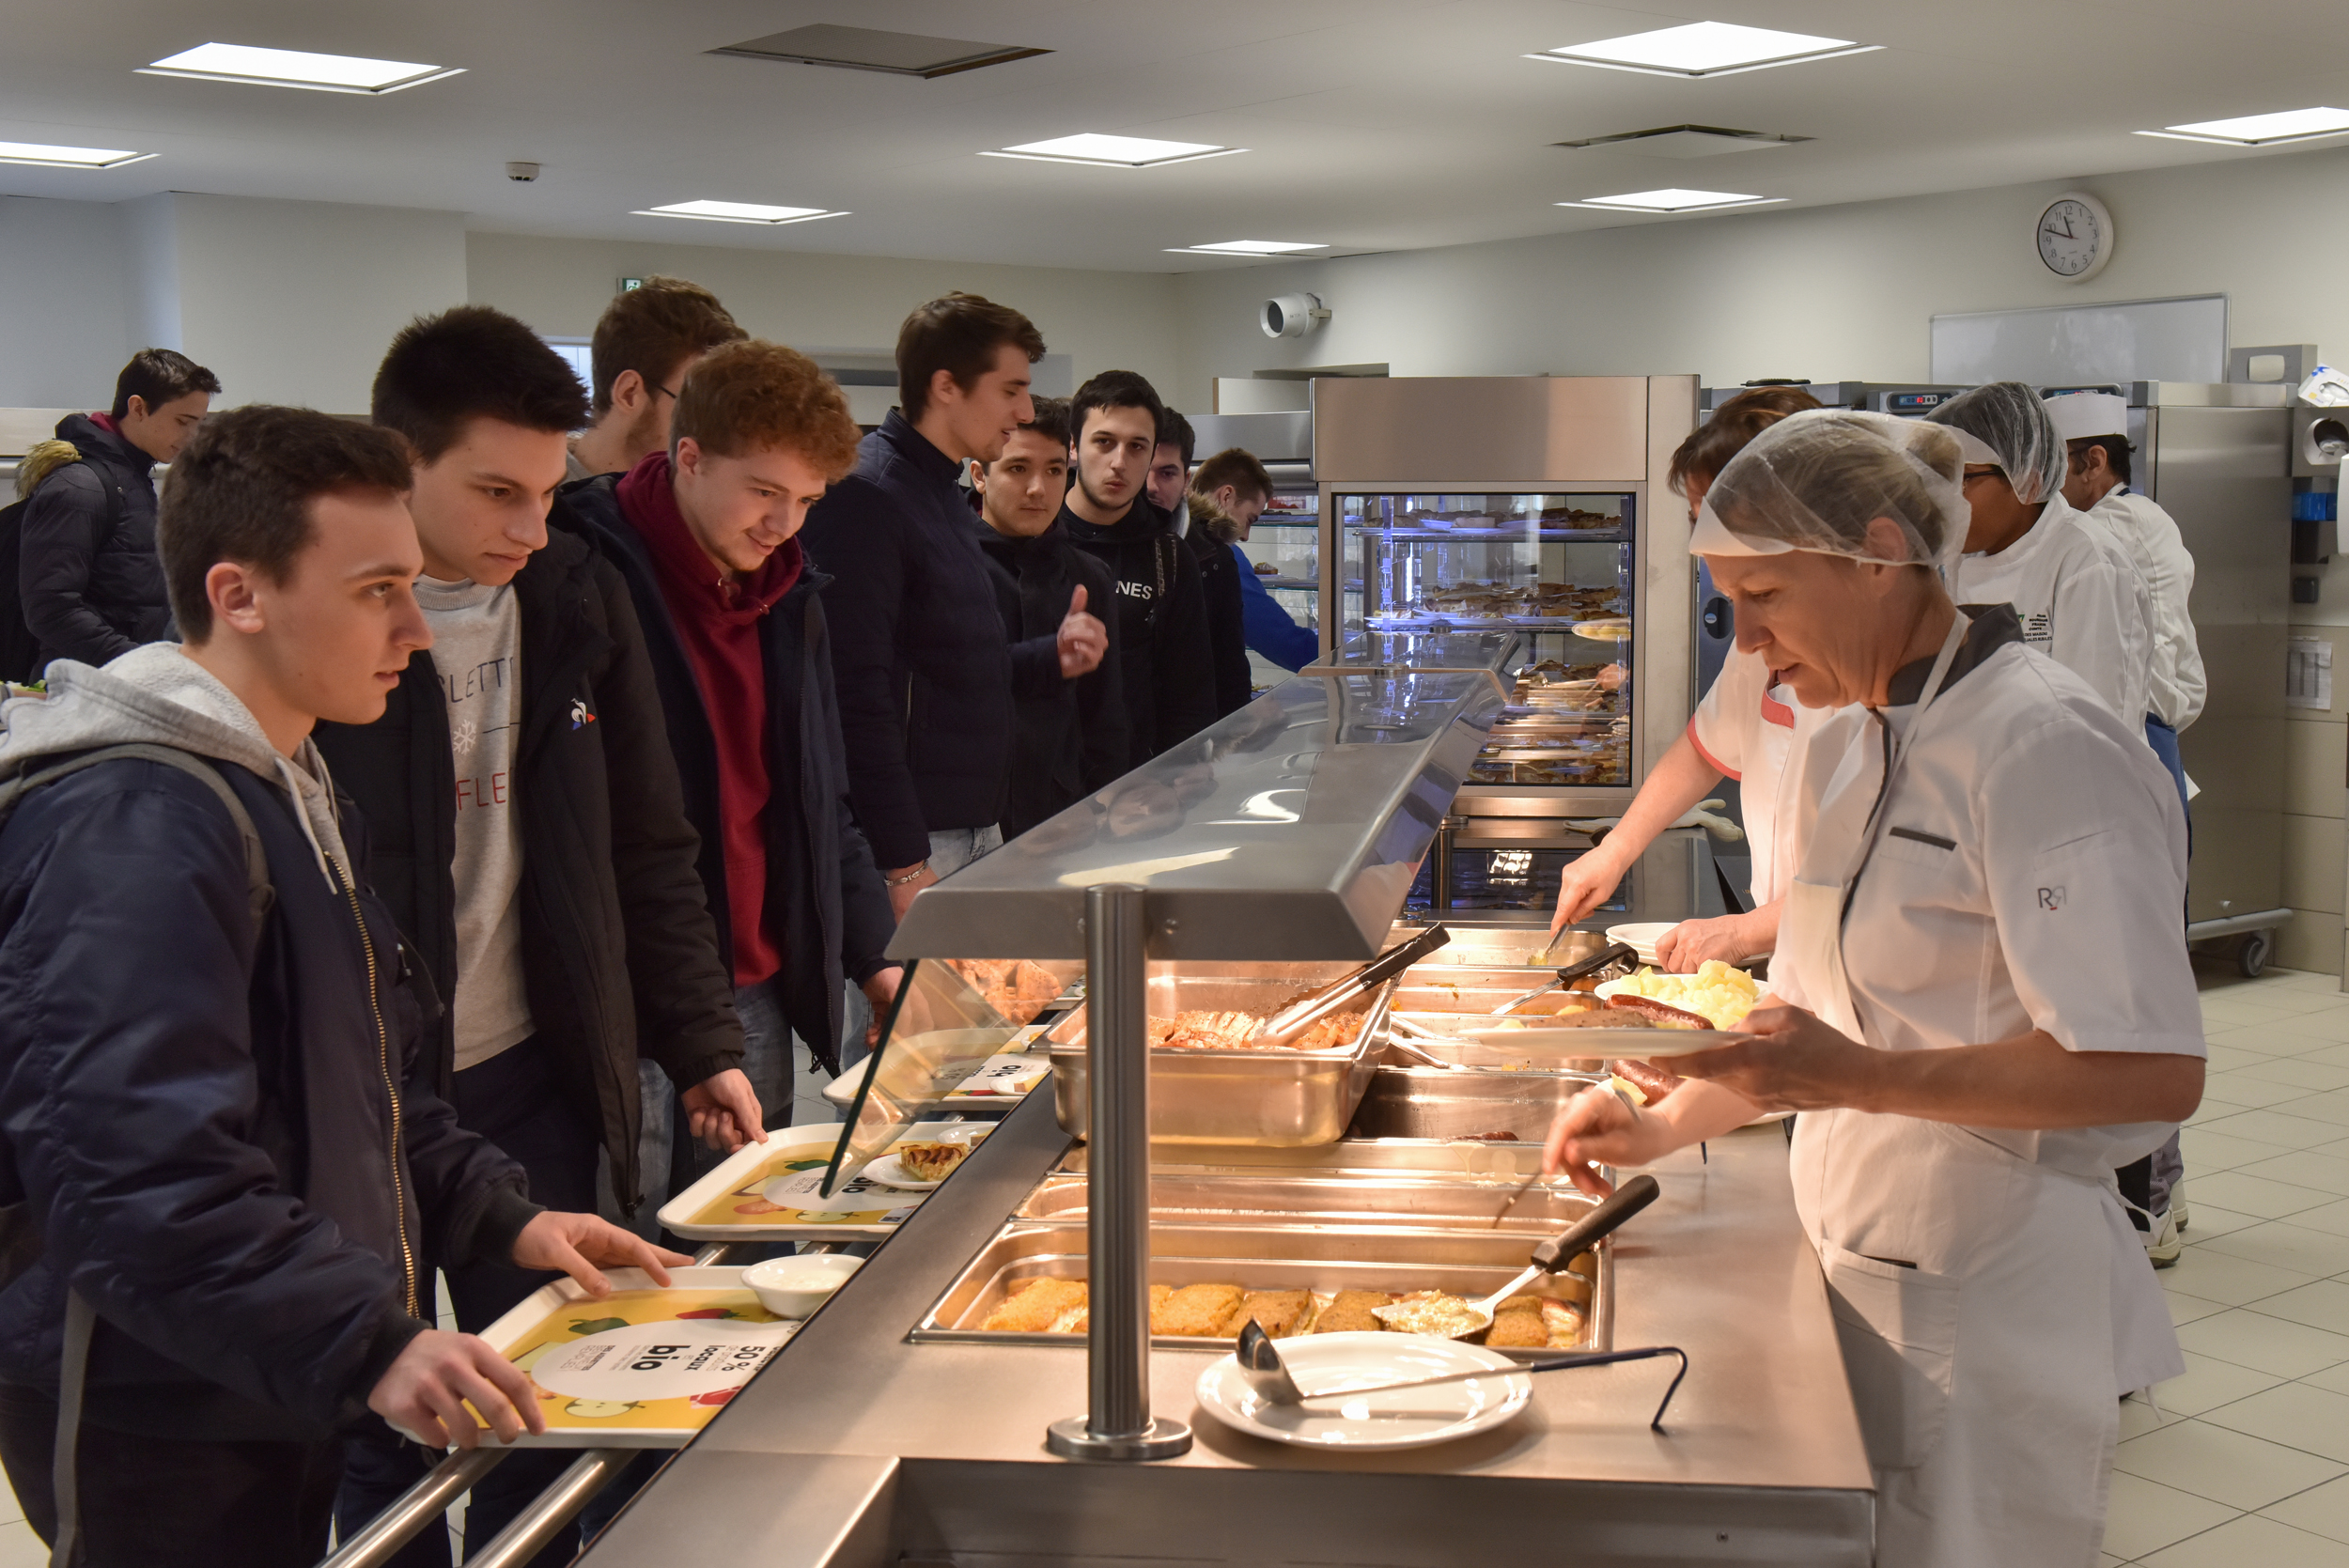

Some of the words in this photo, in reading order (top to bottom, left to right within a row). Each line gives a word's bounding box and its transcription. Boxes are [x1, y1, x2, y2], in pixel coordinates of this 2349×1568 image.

[2064, 206, 2073, 215] 12
[2078, 208, 2083, 217] 1
[2055, 211, 2061, 222] 11
[2088, 216, 2093, 225] 2
[2047, 223, 2056, 232] 10
[2092, 229, 2098, 239] 3
[2046, 236, 2052, 245] 9
[2051, 248, 2057, 258] 8
[2090, 244, 2095, 254] 4
[2061, 256, 2065, 267] 7
[2071, 259, 2077, 269] 6
[2082, 255, 2088, 264] 5
[438, 657, 513, 703] LETT
[987, 1064, 1022, 1078] bio
[734, 1345, 767, 1359] 50
[630, 1344, 692, 1371] bio
[684, 1344, 726, 1371] locaux
[722, 1361, 750, 1372] %
